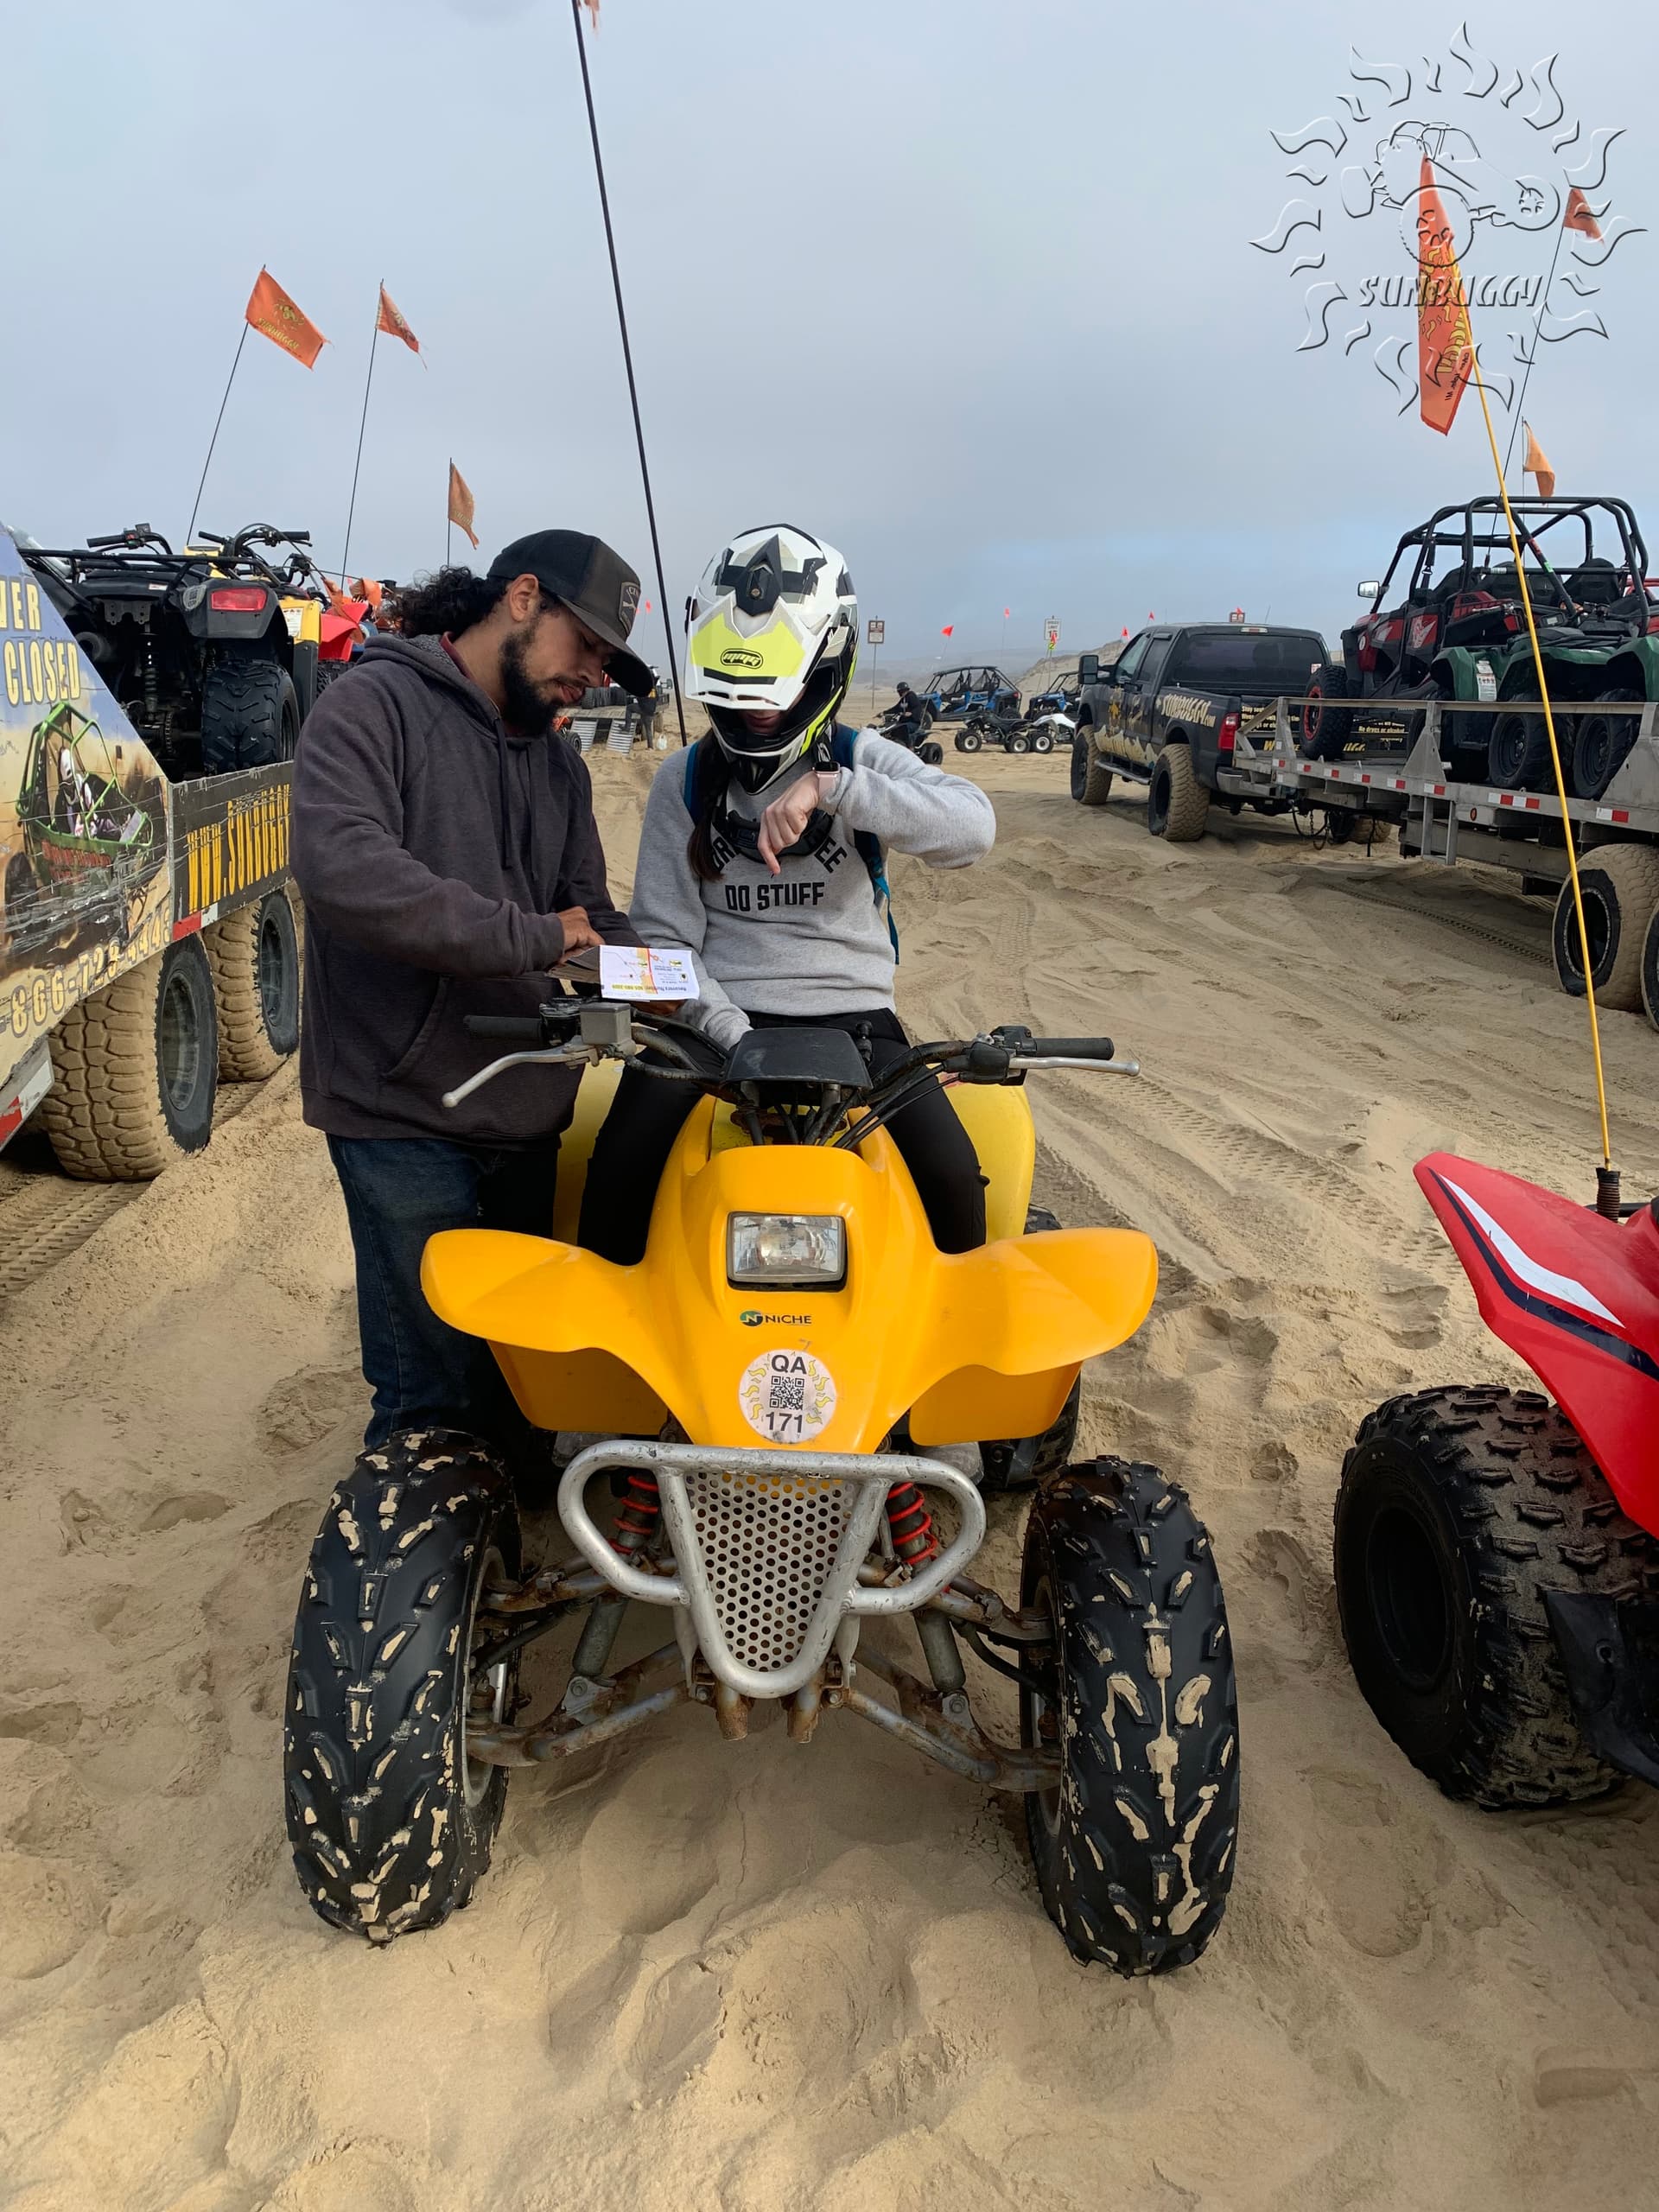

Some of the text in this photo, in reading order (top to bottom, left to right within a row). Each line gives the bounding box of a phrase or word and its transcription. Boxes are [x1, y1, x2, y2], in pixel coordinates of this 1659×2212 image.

[3, 639, 80, 707] CLOSED
[724, 881, 825, 912] DO STUFF
[765, 1314, 812, 1325] NICHE
[771, 1354, 807, 1375] QA
[766, 1411, 804, 1433] 171
